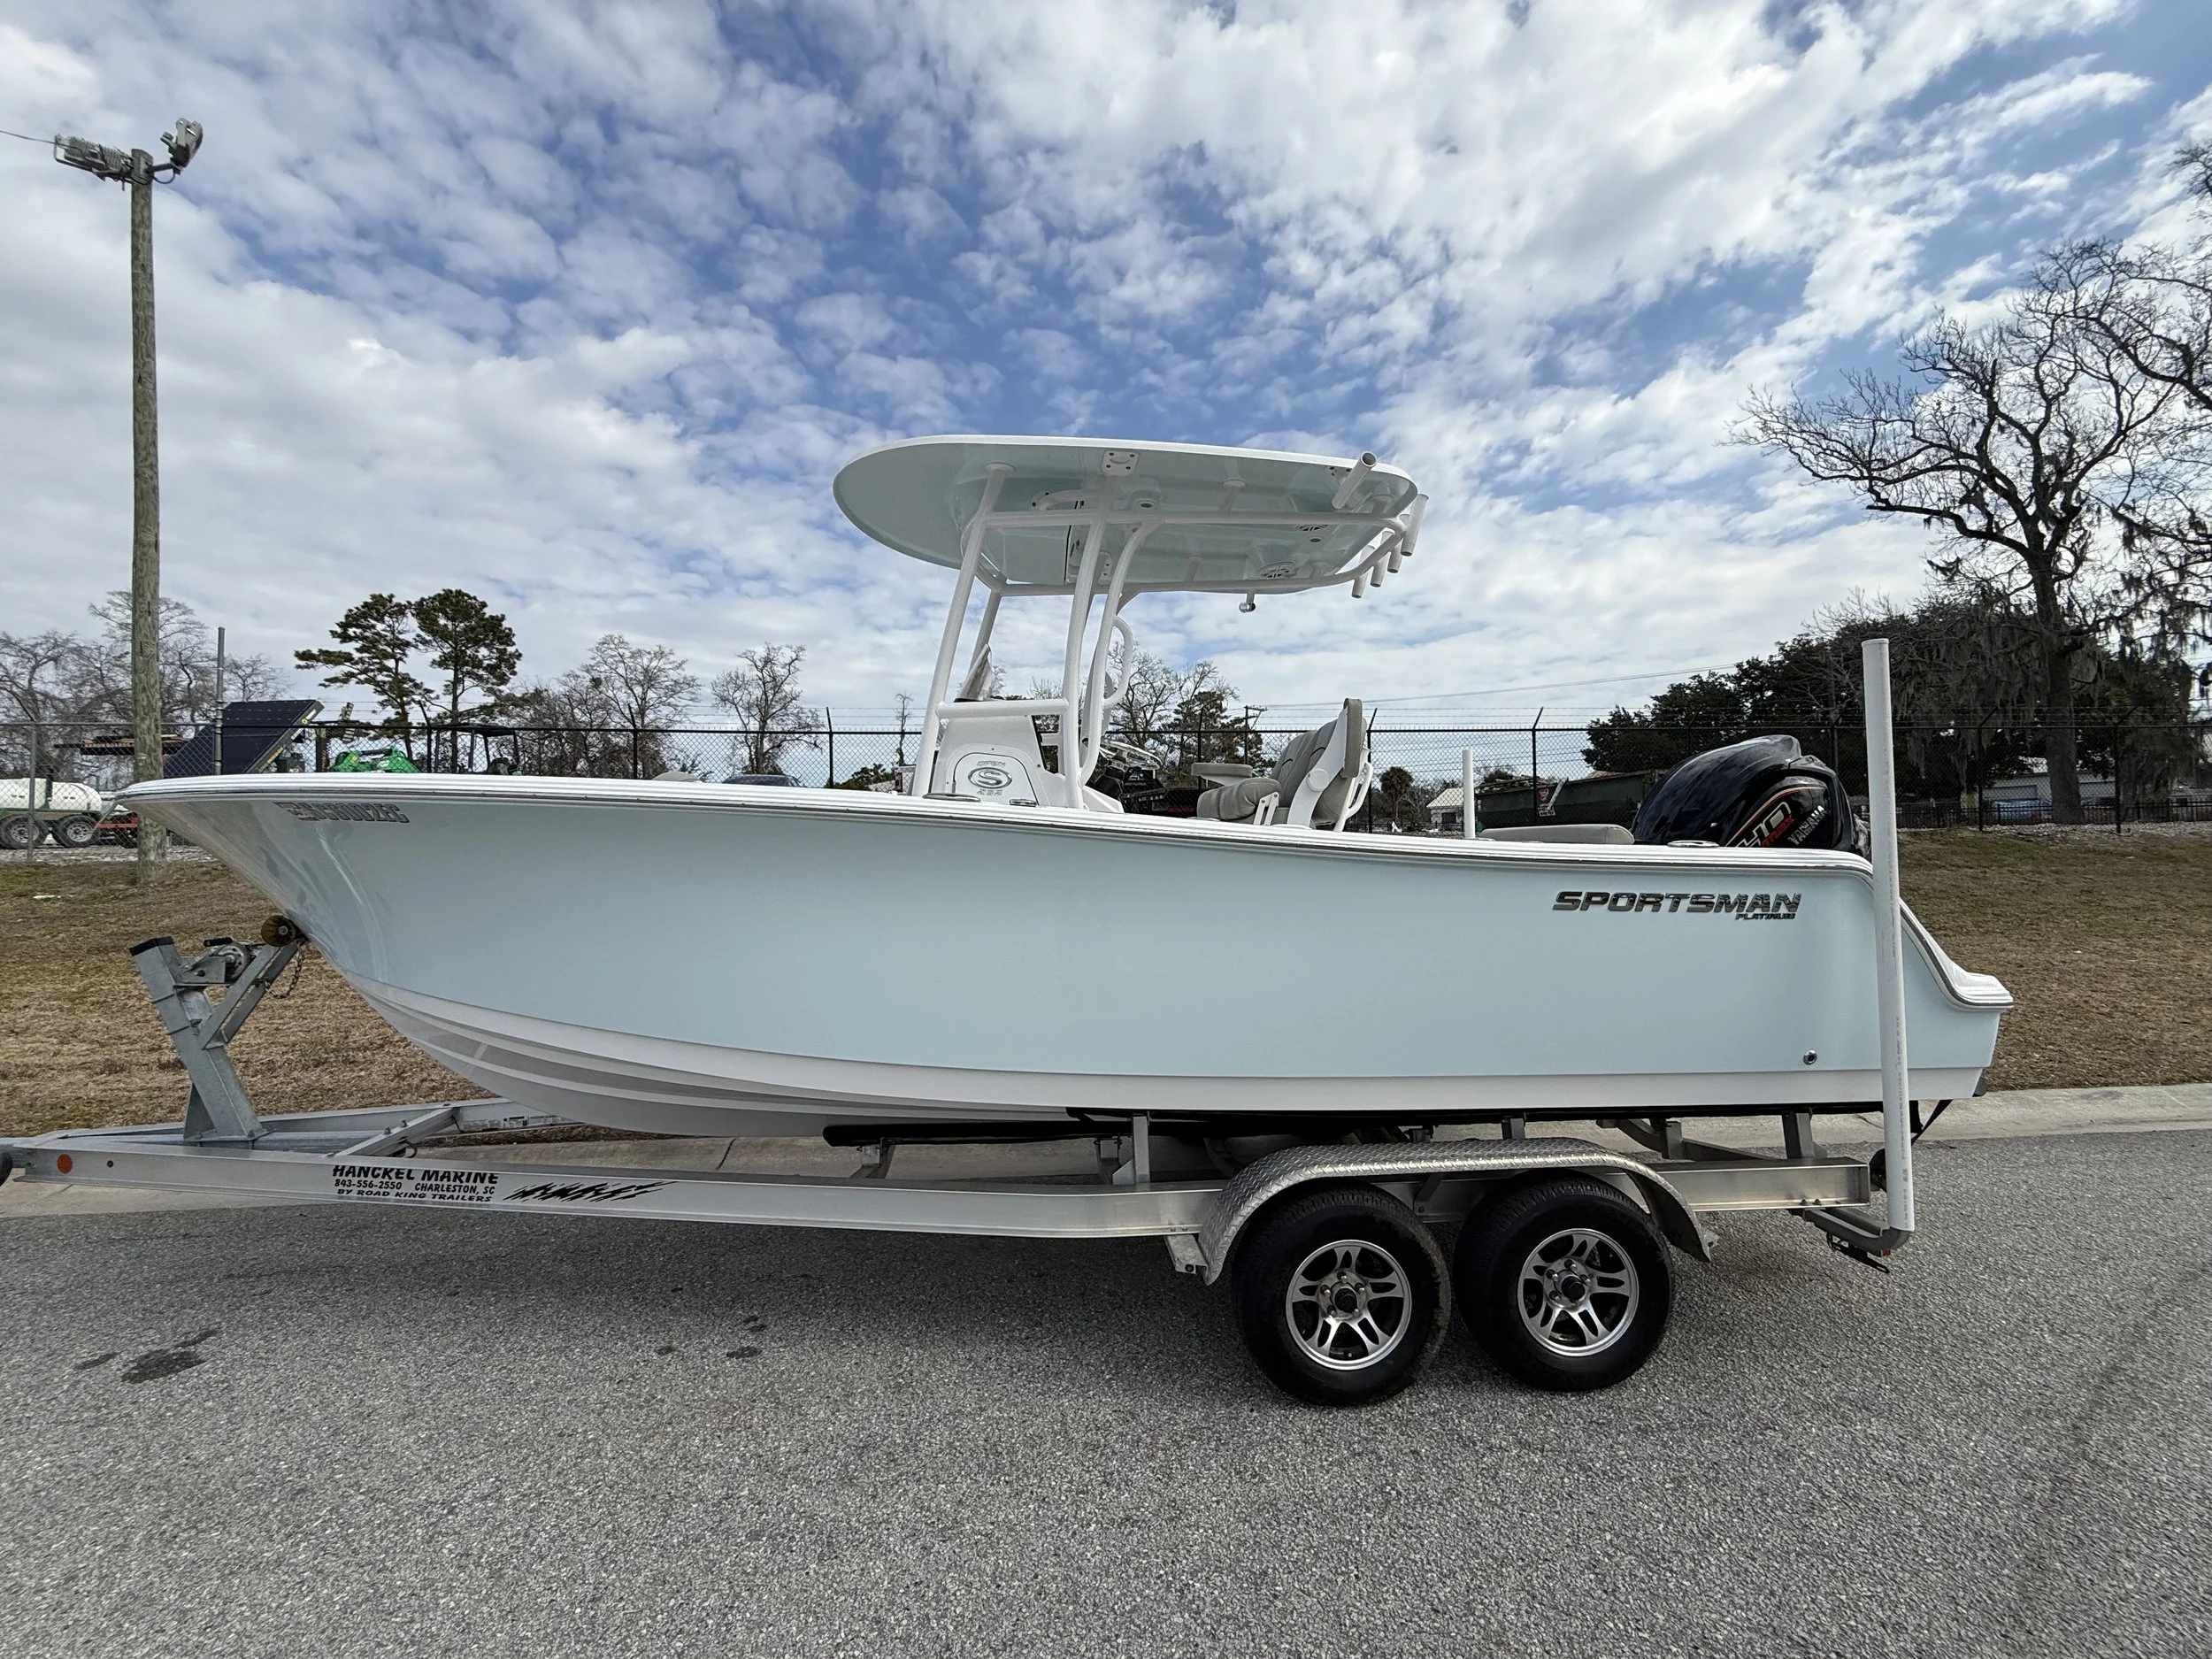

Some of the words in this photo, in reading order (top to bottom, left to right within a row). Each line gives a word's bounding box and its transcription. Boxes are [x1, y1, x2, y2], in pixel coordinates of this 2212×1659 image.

[1787, 805, 1828, 845] YAMAHA
[1552, 890, 1802, 912] SPORTSMAN
[332, 1164, 415, 1180] HANCKEL
[421, 1170, 498, 1184] MARINE
[334, 1179, 403, 1190] 843-556-2550
[415, 1182, 480, 1195] CHARLESTON,
[483, 1186, 495, 1194] SC
[432, 1193, 492, 1202] TRAILERS
